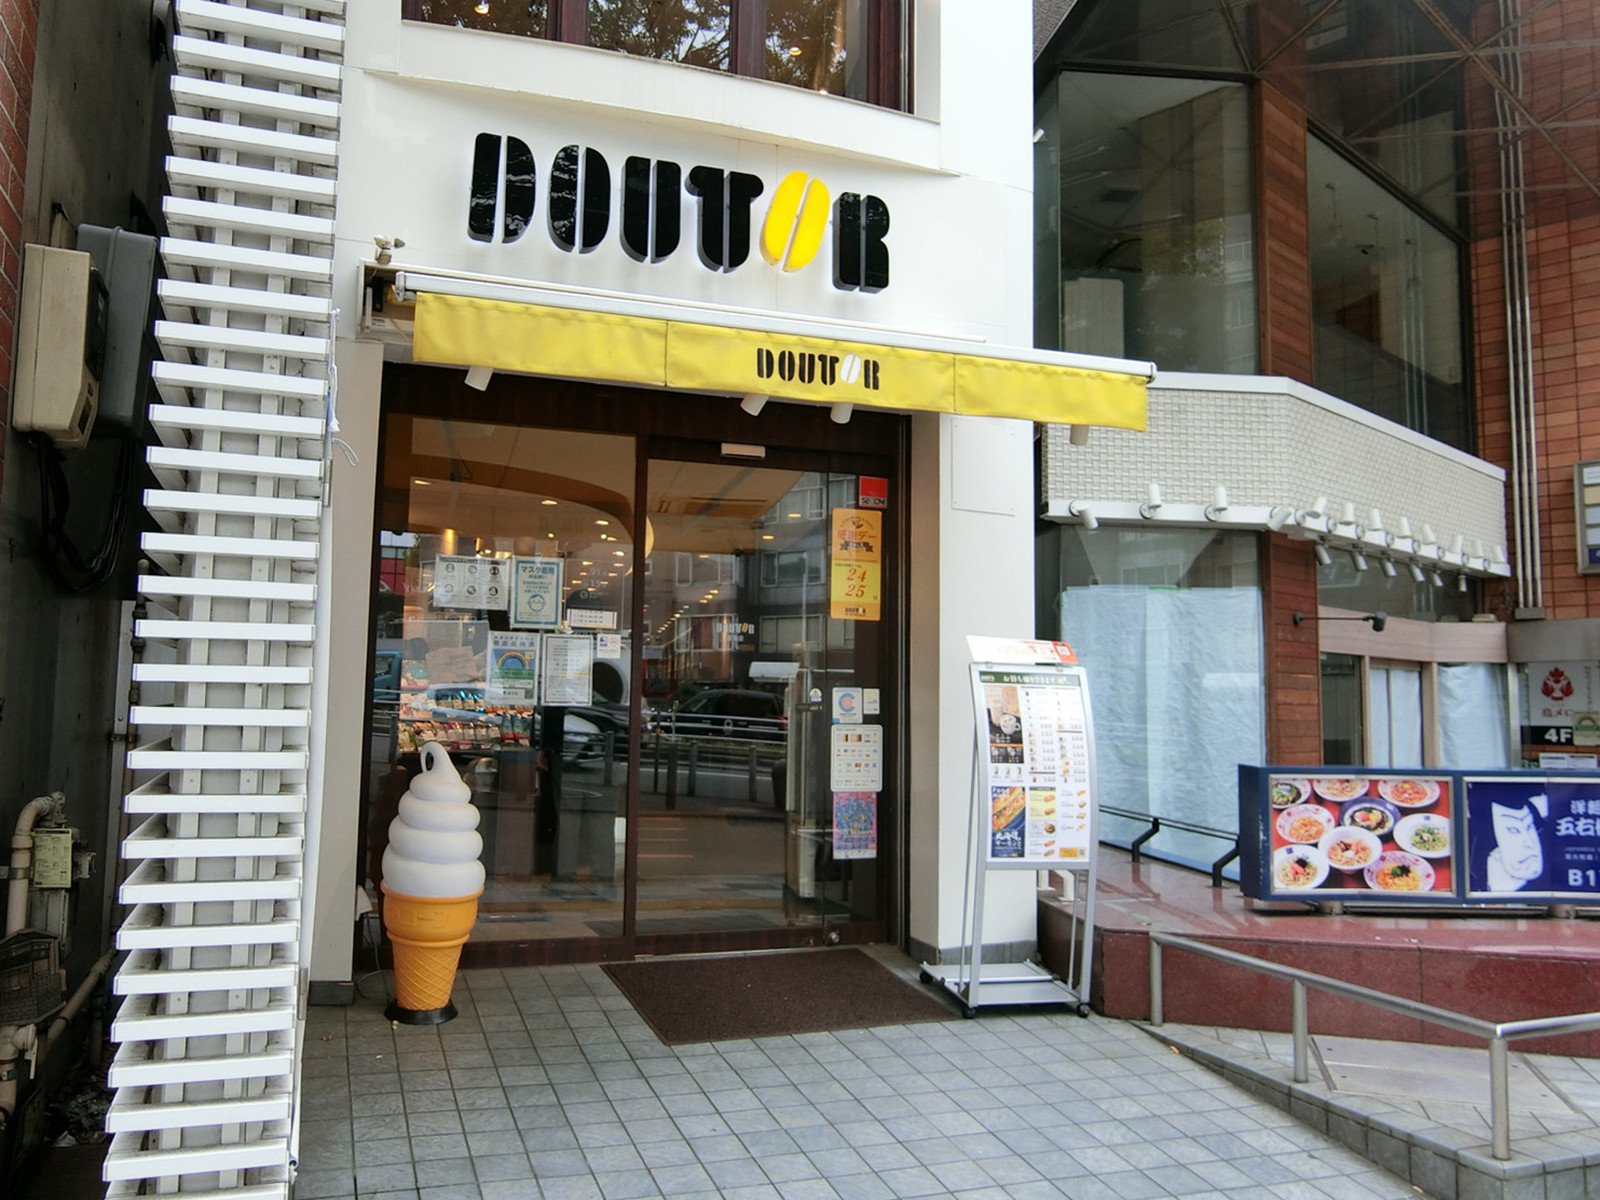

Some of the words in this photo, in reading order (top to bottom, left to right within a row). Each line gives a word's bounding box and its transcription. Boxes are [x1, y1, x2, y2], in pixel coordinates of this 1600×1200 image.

[467, 132, 889, 293] DOUTOR
[757, 347, 880, 390] DOUTOR
[847, 568, 867, 582] 24
[845, 584, 867, 598] 25
[1544, 728, 1572, 743] 4F
[1555, 816, 1600, 837] 五右
[1568, 868, 1600, 888] B1
